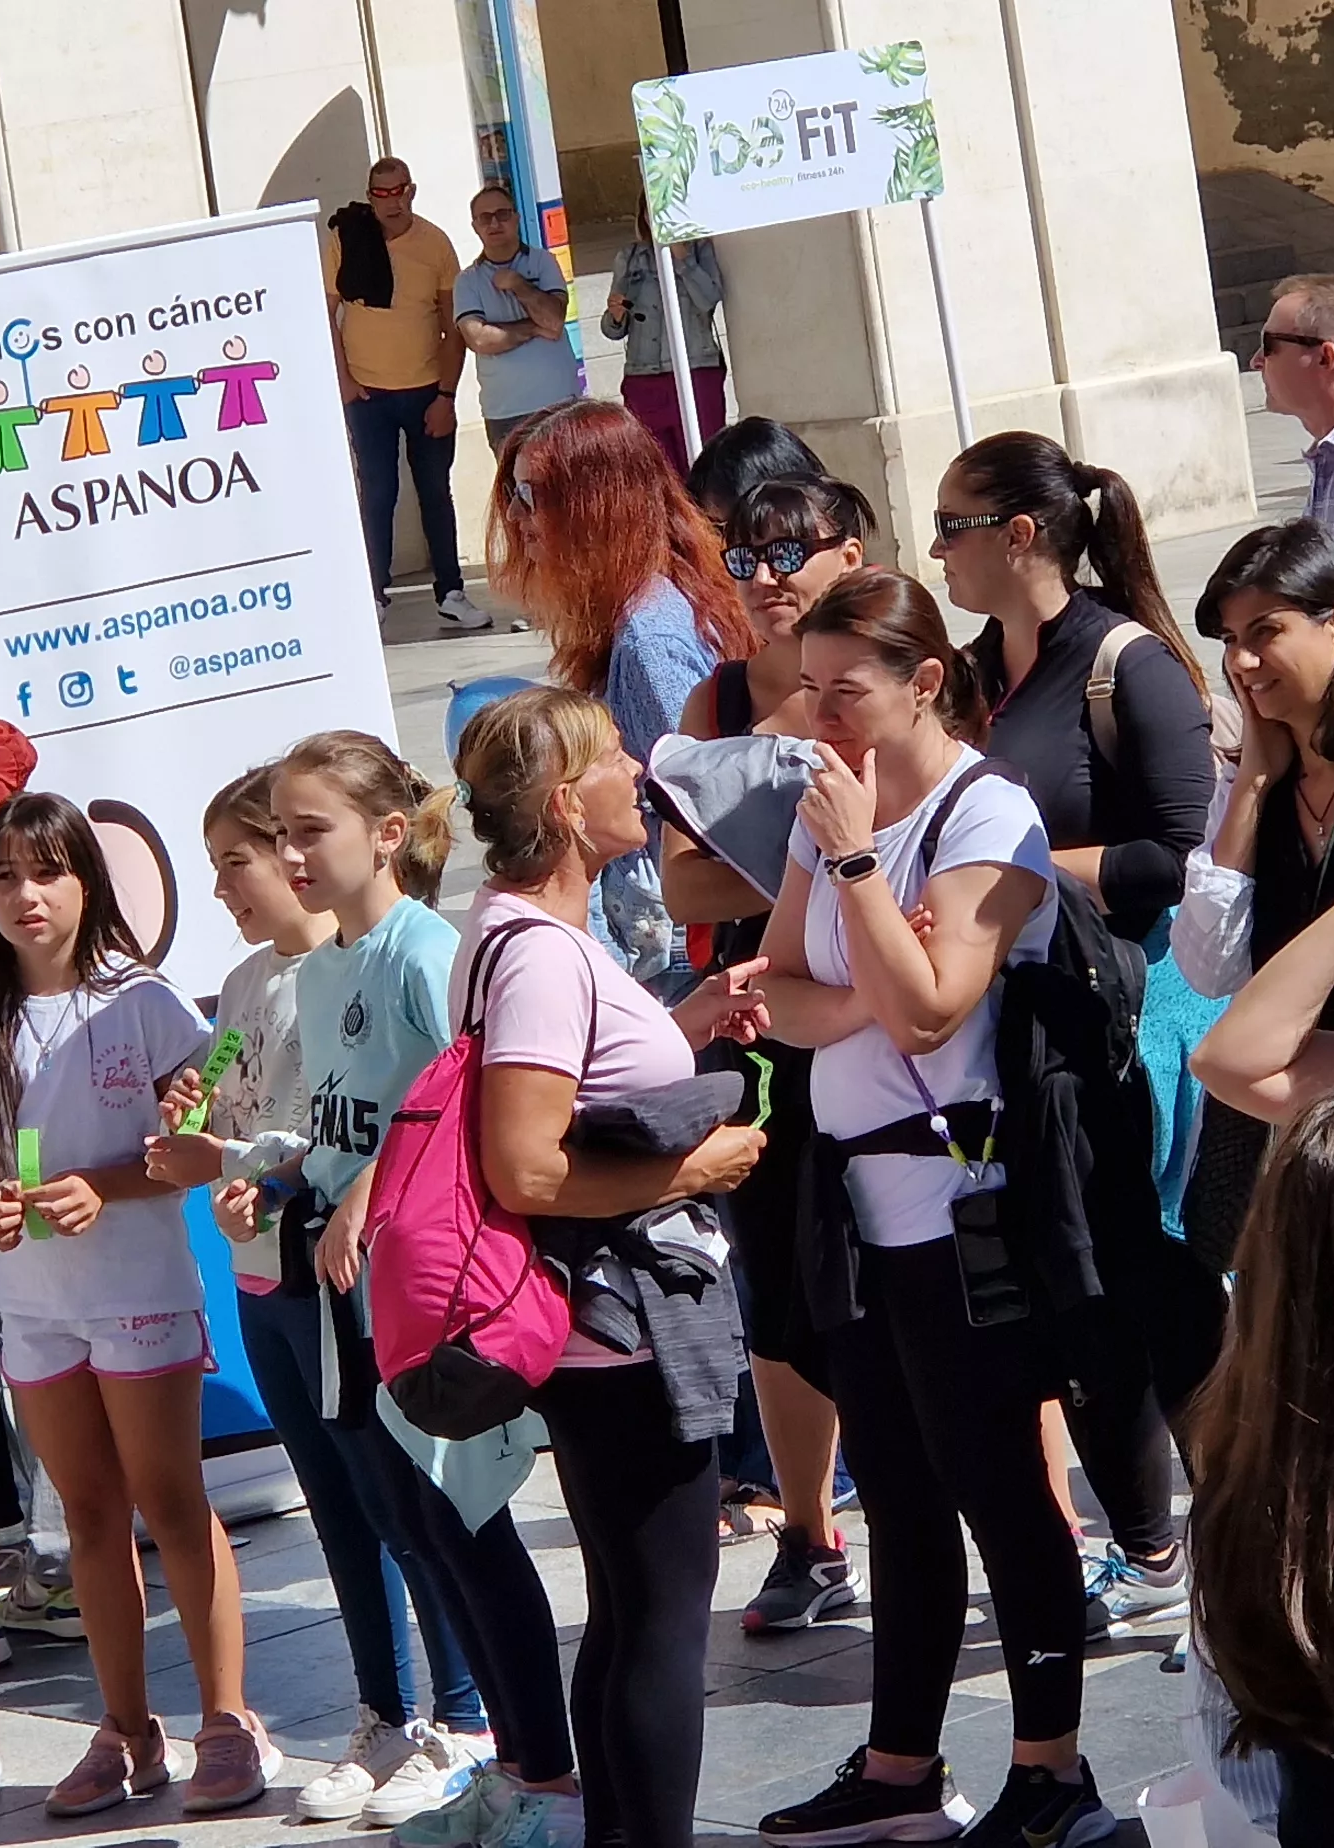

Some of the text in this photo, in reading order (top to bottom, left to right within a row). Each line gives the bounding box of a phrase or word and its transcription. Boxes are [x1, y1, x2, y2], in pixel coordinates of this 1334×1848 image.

[703, 111, 785, 176] be
[797, 169, 826, 182] fitness
[827, 165, 844, 177] 24h
[74, 313, 137, 345] con
[147, 287, 267, 332] cáncer
[14, 450, 262, 540] ASPANOA
[3, 580, 292, 658] www.aspanoa.org
[169, 638, 303, 680] @aspanoa
